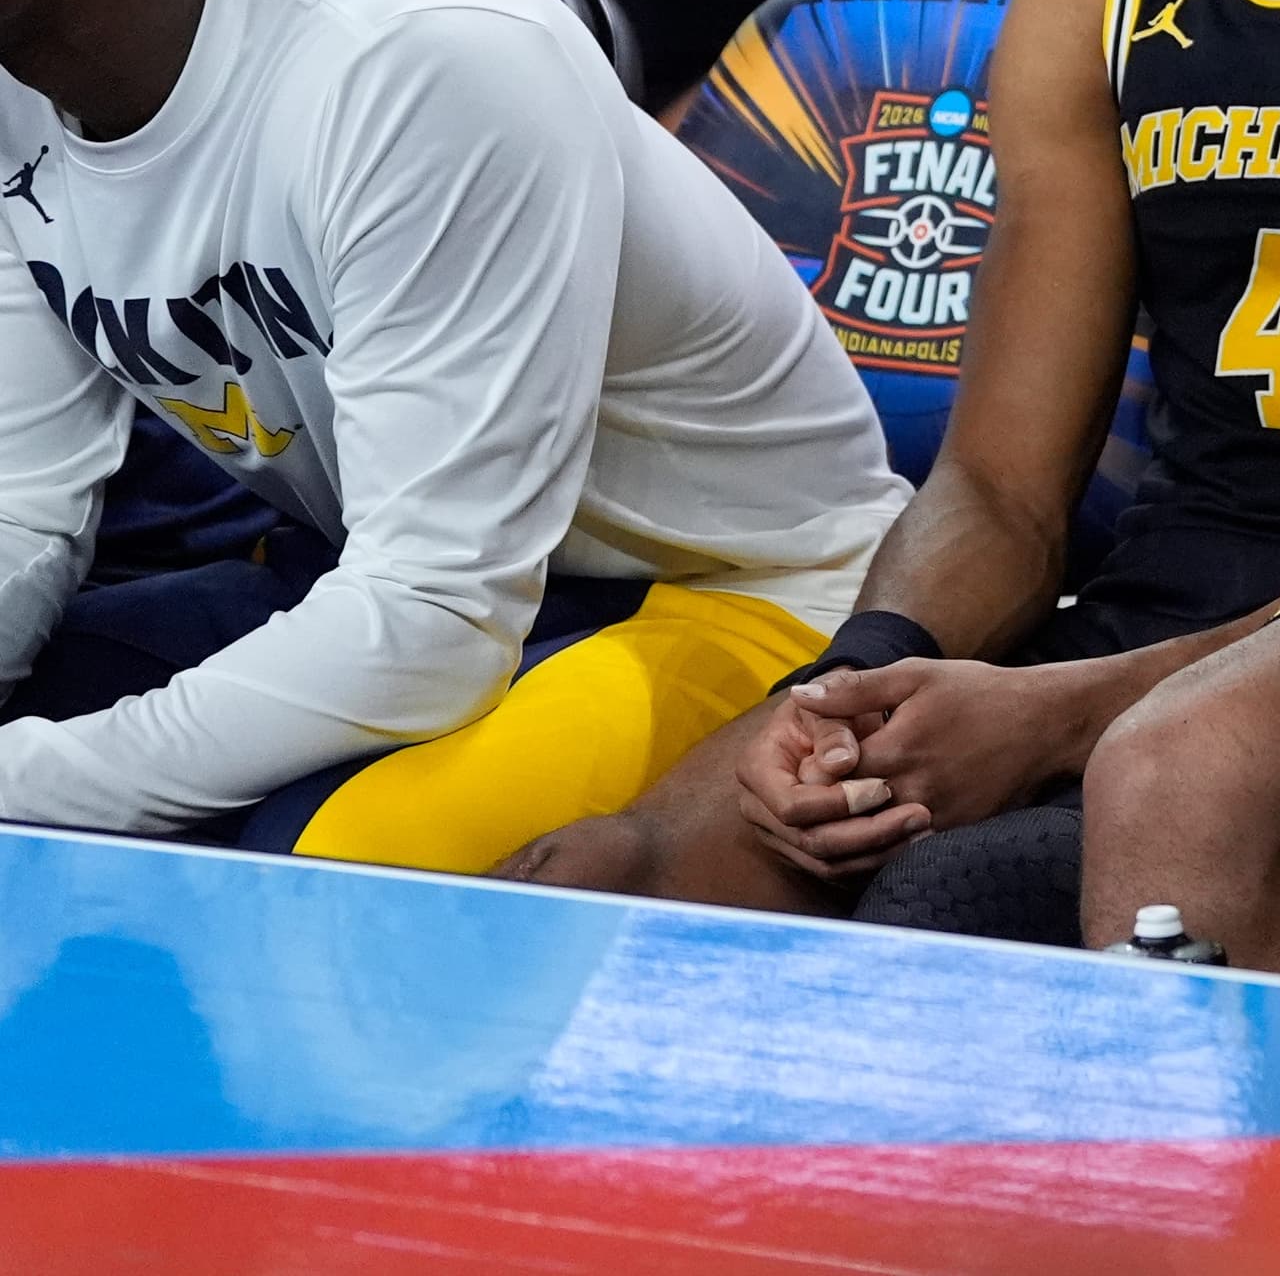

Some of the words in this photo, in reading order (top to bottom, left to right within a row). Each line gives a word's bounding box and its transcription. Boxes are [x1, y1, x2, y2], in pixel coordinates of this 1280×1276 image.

[878, 103, 925, 128] 2026
[863, 140, 997, 207] FINAL
[834, 257, 971, 325] FOUR
[833, 326, 961, 363] NDIANAPOLIS
[152, 381, 295, 458] M
